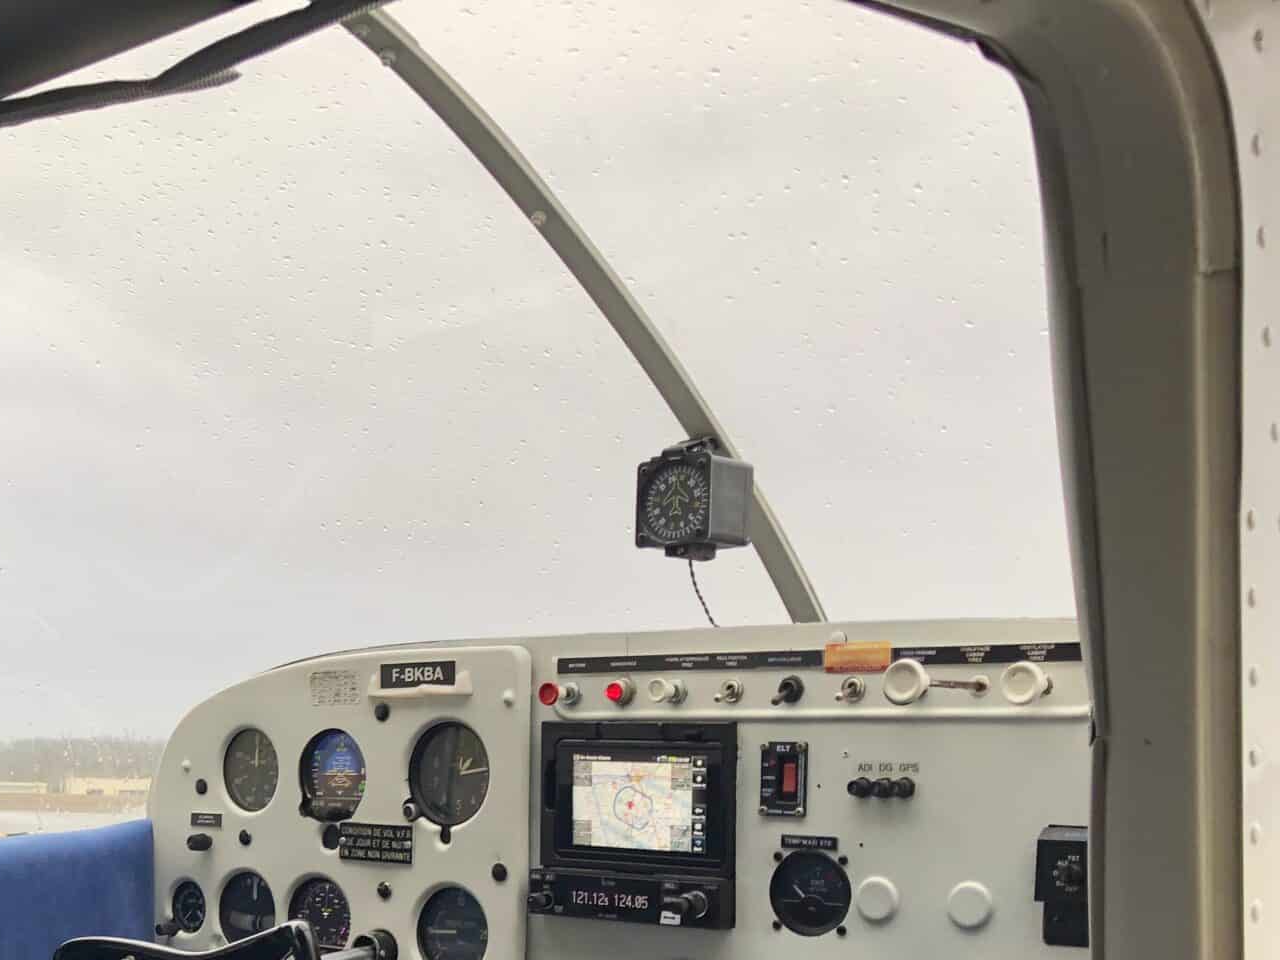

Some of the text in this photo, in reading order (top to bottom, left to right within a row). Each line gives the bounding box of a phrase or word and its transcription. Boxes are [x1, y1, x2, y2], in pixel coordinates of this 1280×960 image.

[392, 667, 444, 682] F-BKBA
[899, 763, 919, 773] GPS
[614, 893, 649, 909] 124.05
